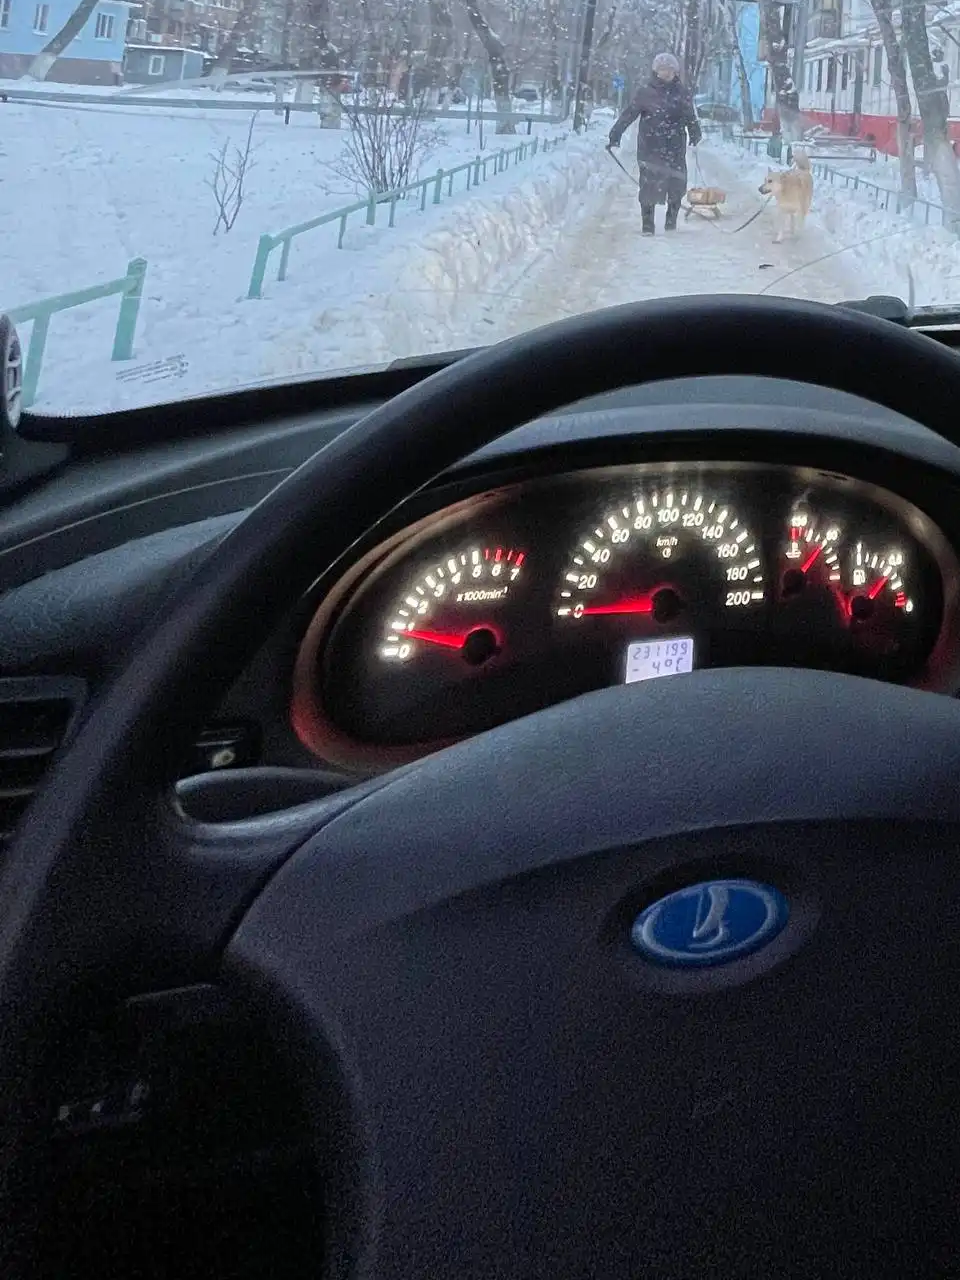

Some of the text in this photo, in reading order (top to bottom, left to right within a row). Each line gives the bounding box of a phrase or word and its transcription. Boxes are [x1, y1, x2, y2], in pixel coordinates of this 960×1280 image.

[633, 515, 652, 530] 80
[657, 508, 680, 524] 100
[682, 513, 705, 528] 120
[611, 528, 630, 544] 60
[702, 525, 724, 540] 140
[656, 536, 679, 547] km/h
[591, 548, 611, 564] 40
[717, 543, 740, 559] 160
[491, 563, 502, 577] 6
[510, 567, 521, 582] 7
[725, 566, 748, 582] 180
[451, 571, 462, 585] 4
[578, 574, 598, 590] 20
[433, 583, 445, 598] 3
[725, 591, 751, 606] 200
[417, 600, 429, 615] 2
[573, 603, 585, 619] 0
[398, 644, 411, 659] 0
[632, 641, 689, 661] 231199
